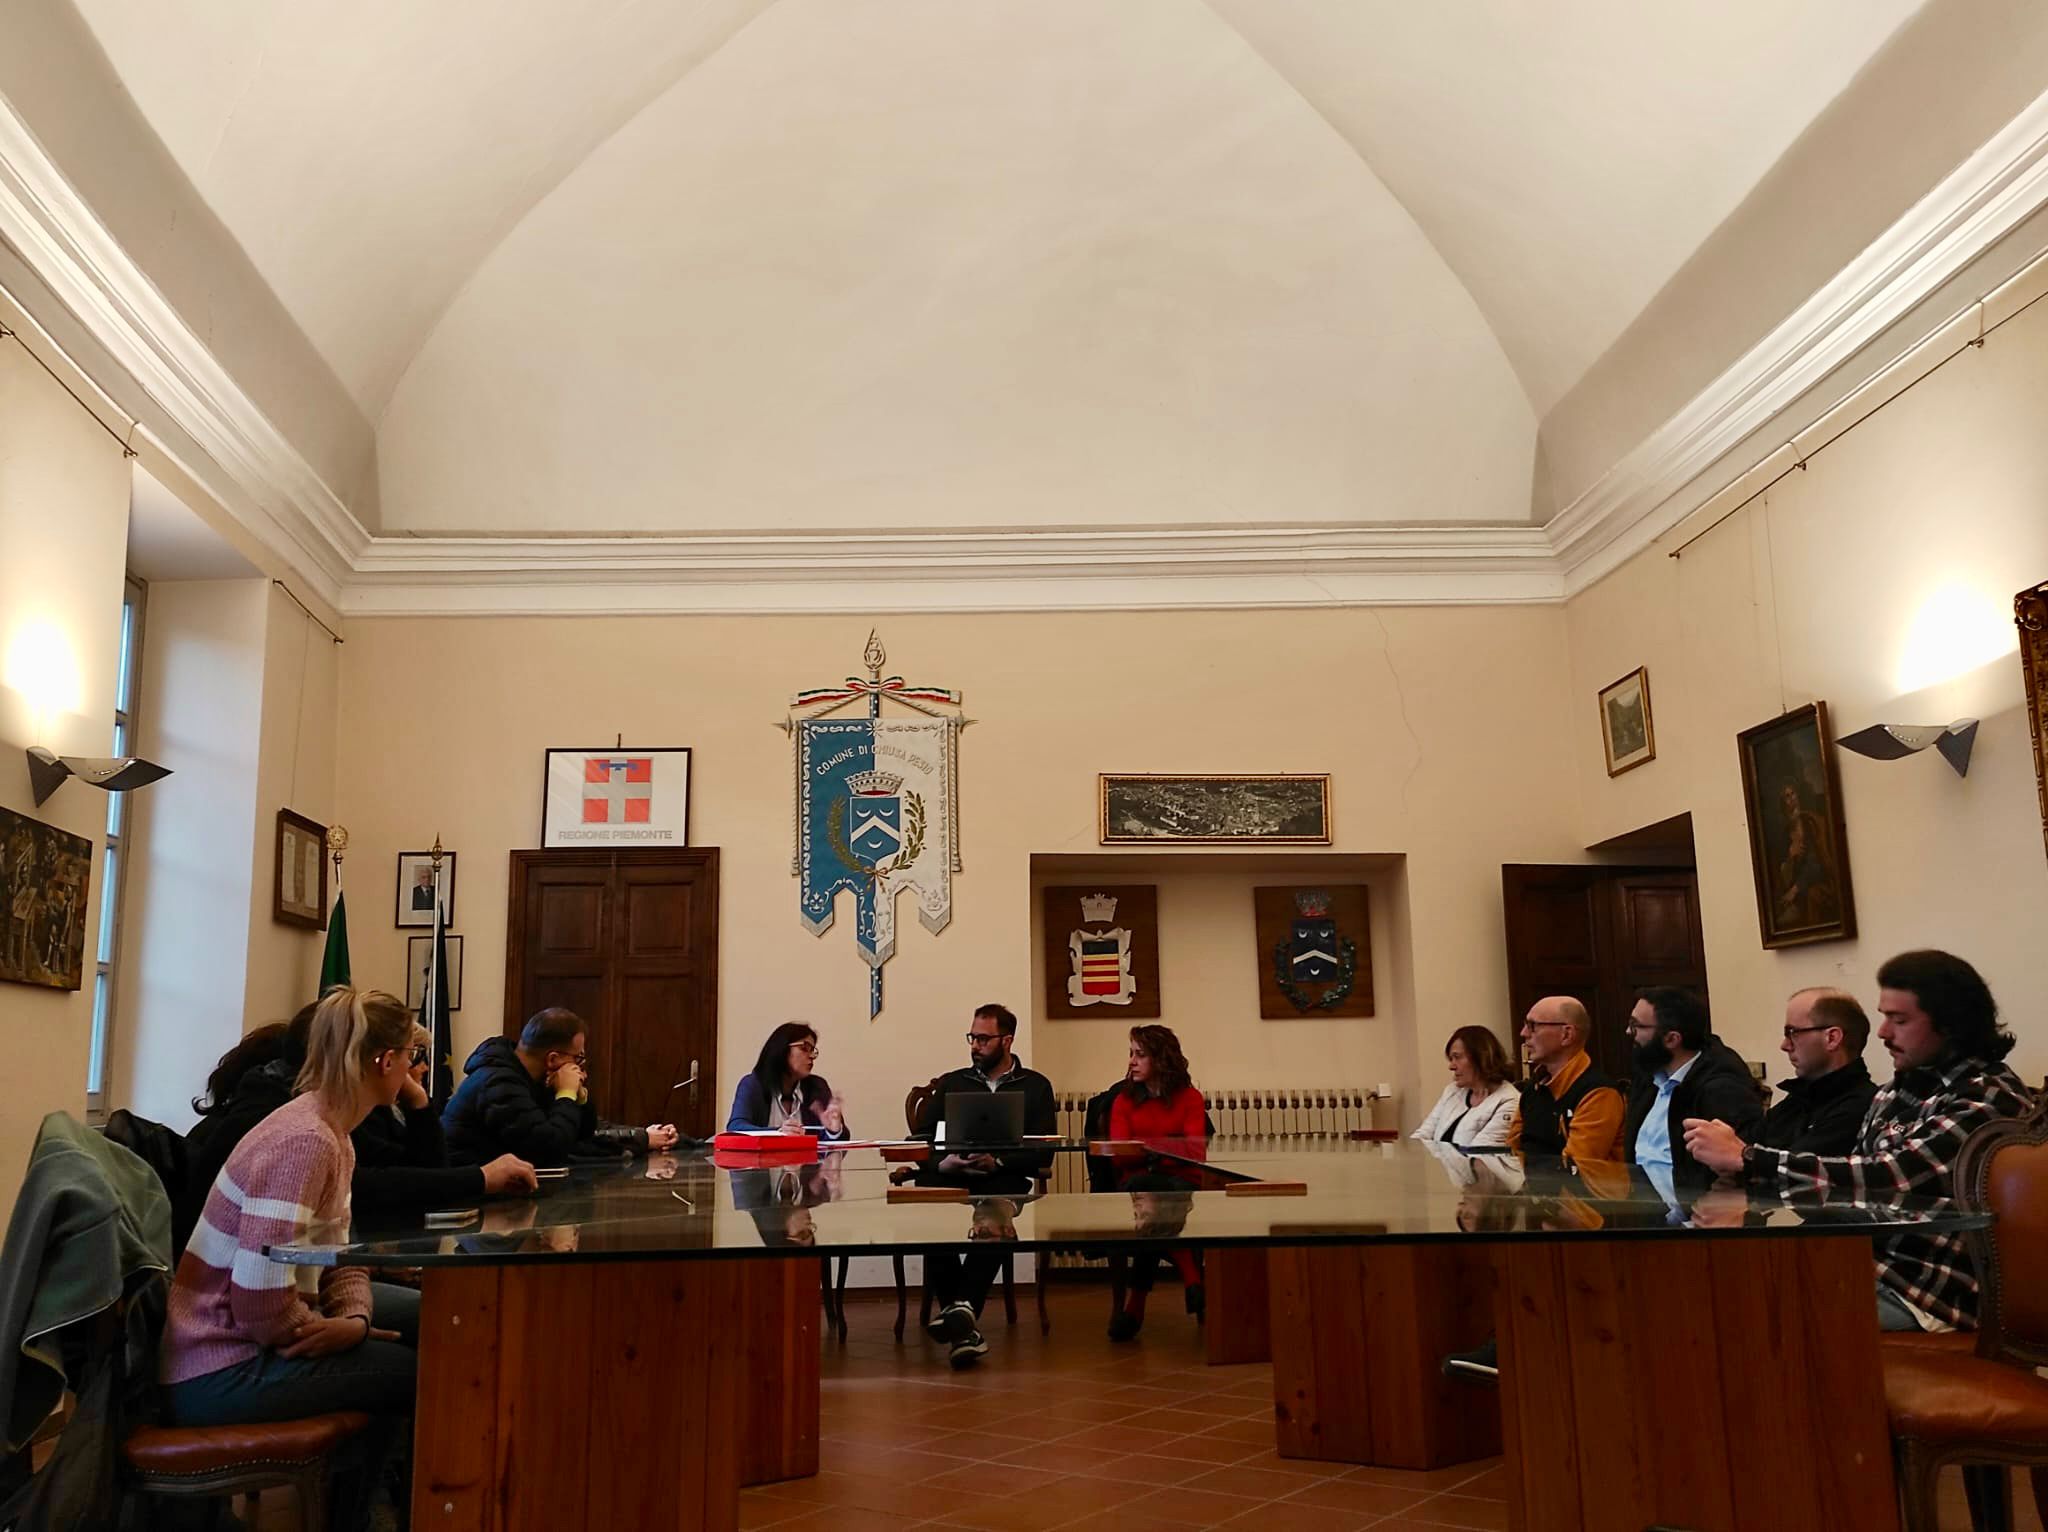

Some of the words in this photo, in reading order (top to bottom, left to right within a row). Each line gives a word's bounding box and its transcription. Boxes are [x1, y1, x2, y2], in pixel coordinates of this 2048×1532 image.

[816, 747, 855, 775] COMUNE
[858, 745, 868, 755] DI
[558, 830, 610, 840] REGIONE
[612, 830, 673, 840] PIEMONTE
